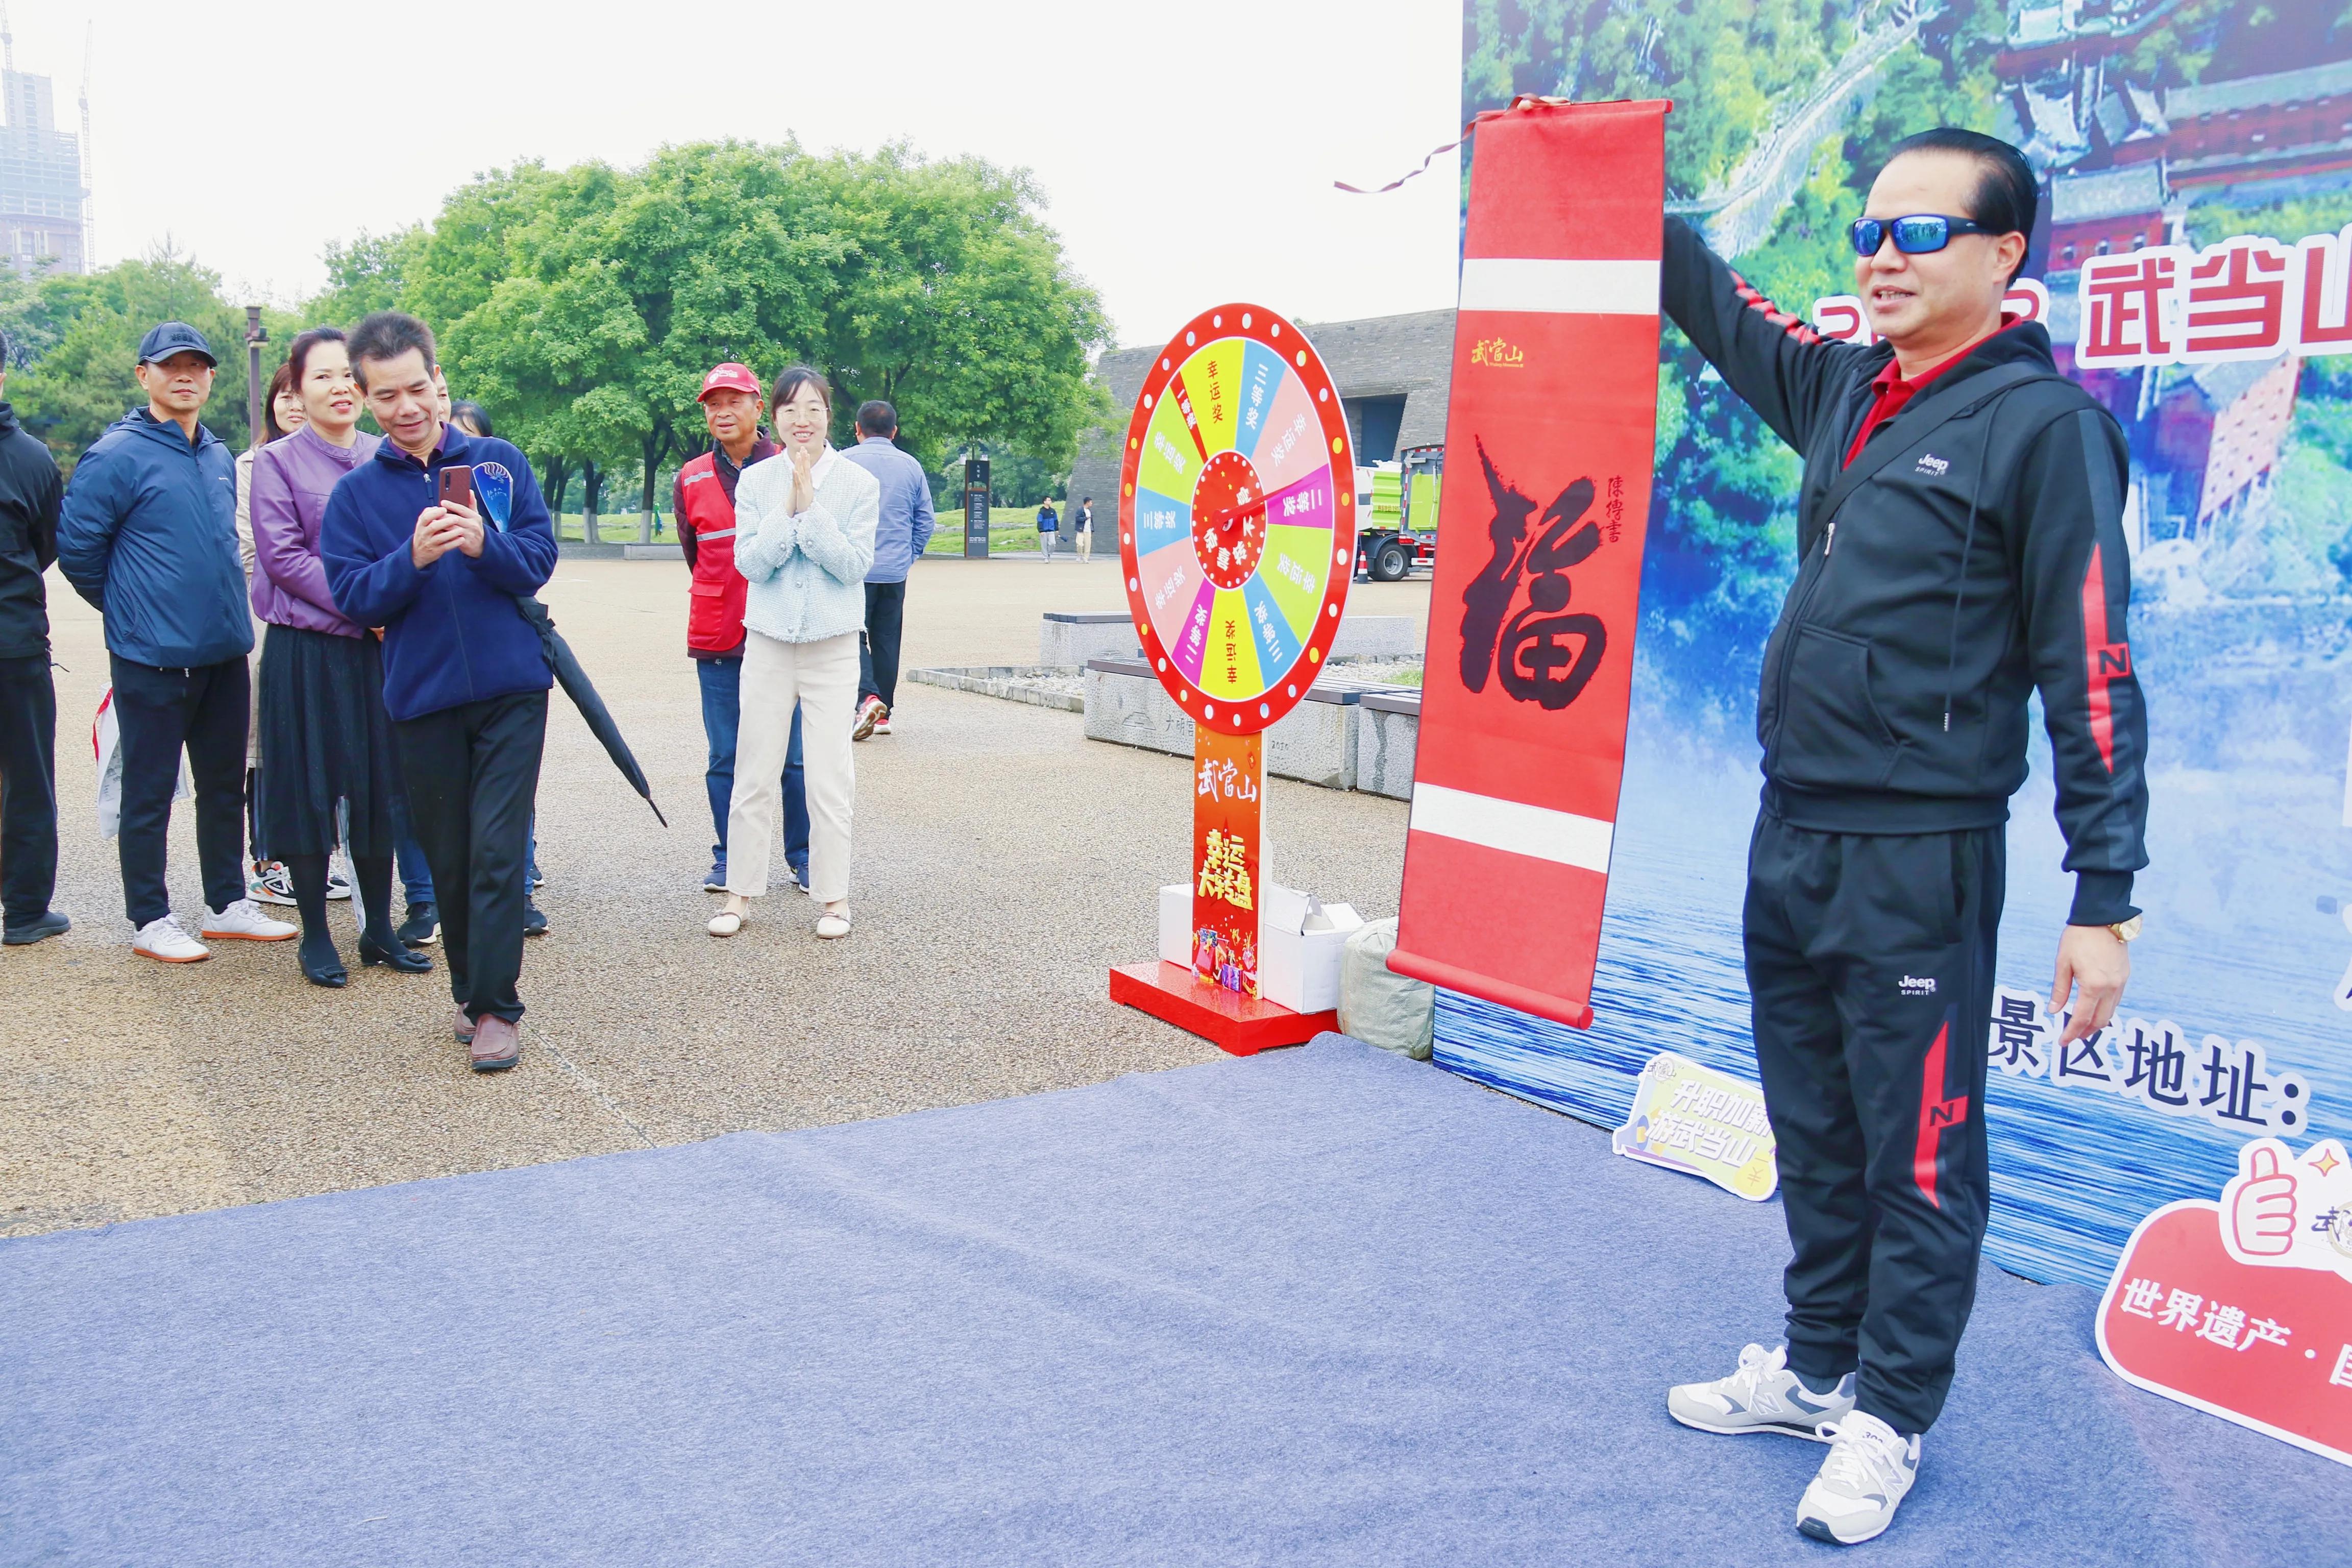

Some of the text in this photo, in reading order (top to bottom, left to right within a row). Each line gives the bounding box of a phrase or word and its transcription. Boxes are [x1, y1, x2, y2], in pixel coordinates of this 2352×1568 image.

[1177, 388, 1197, 430] 一等奖
[1207, 360, 1223, 424] 幸运奖
[1245, 363, 1268, 430] 三等奖
[1154, 431, 1186, 475] 幸运奖
[1271, 412, 1307, 467] 幸运奖
[1915, 466, 1939, 476] SPIRIT
[1918, 453, 1949, 472] Jeep
[1143, 510, 1177, 530] 三等奖
[1283, 488, 1322, 518] 二等奖
[1155, 565, 1186, 610] 幸运奖
[1277, 552, 1316, 595] 幸运奖
[1184, 603, 1208, 665] 二等奖
[1224, 620, 1237, 684] 幸运奖
[1254, 600, 1283, 664] 三等奖
[1205, 828, 1246, 871] 幸运
[1197, 861, 1254, 911] 大转盘
[1898, 975, 1935, 990] Jeep
[1645, 1110, 1757, 1169] 游武当山
